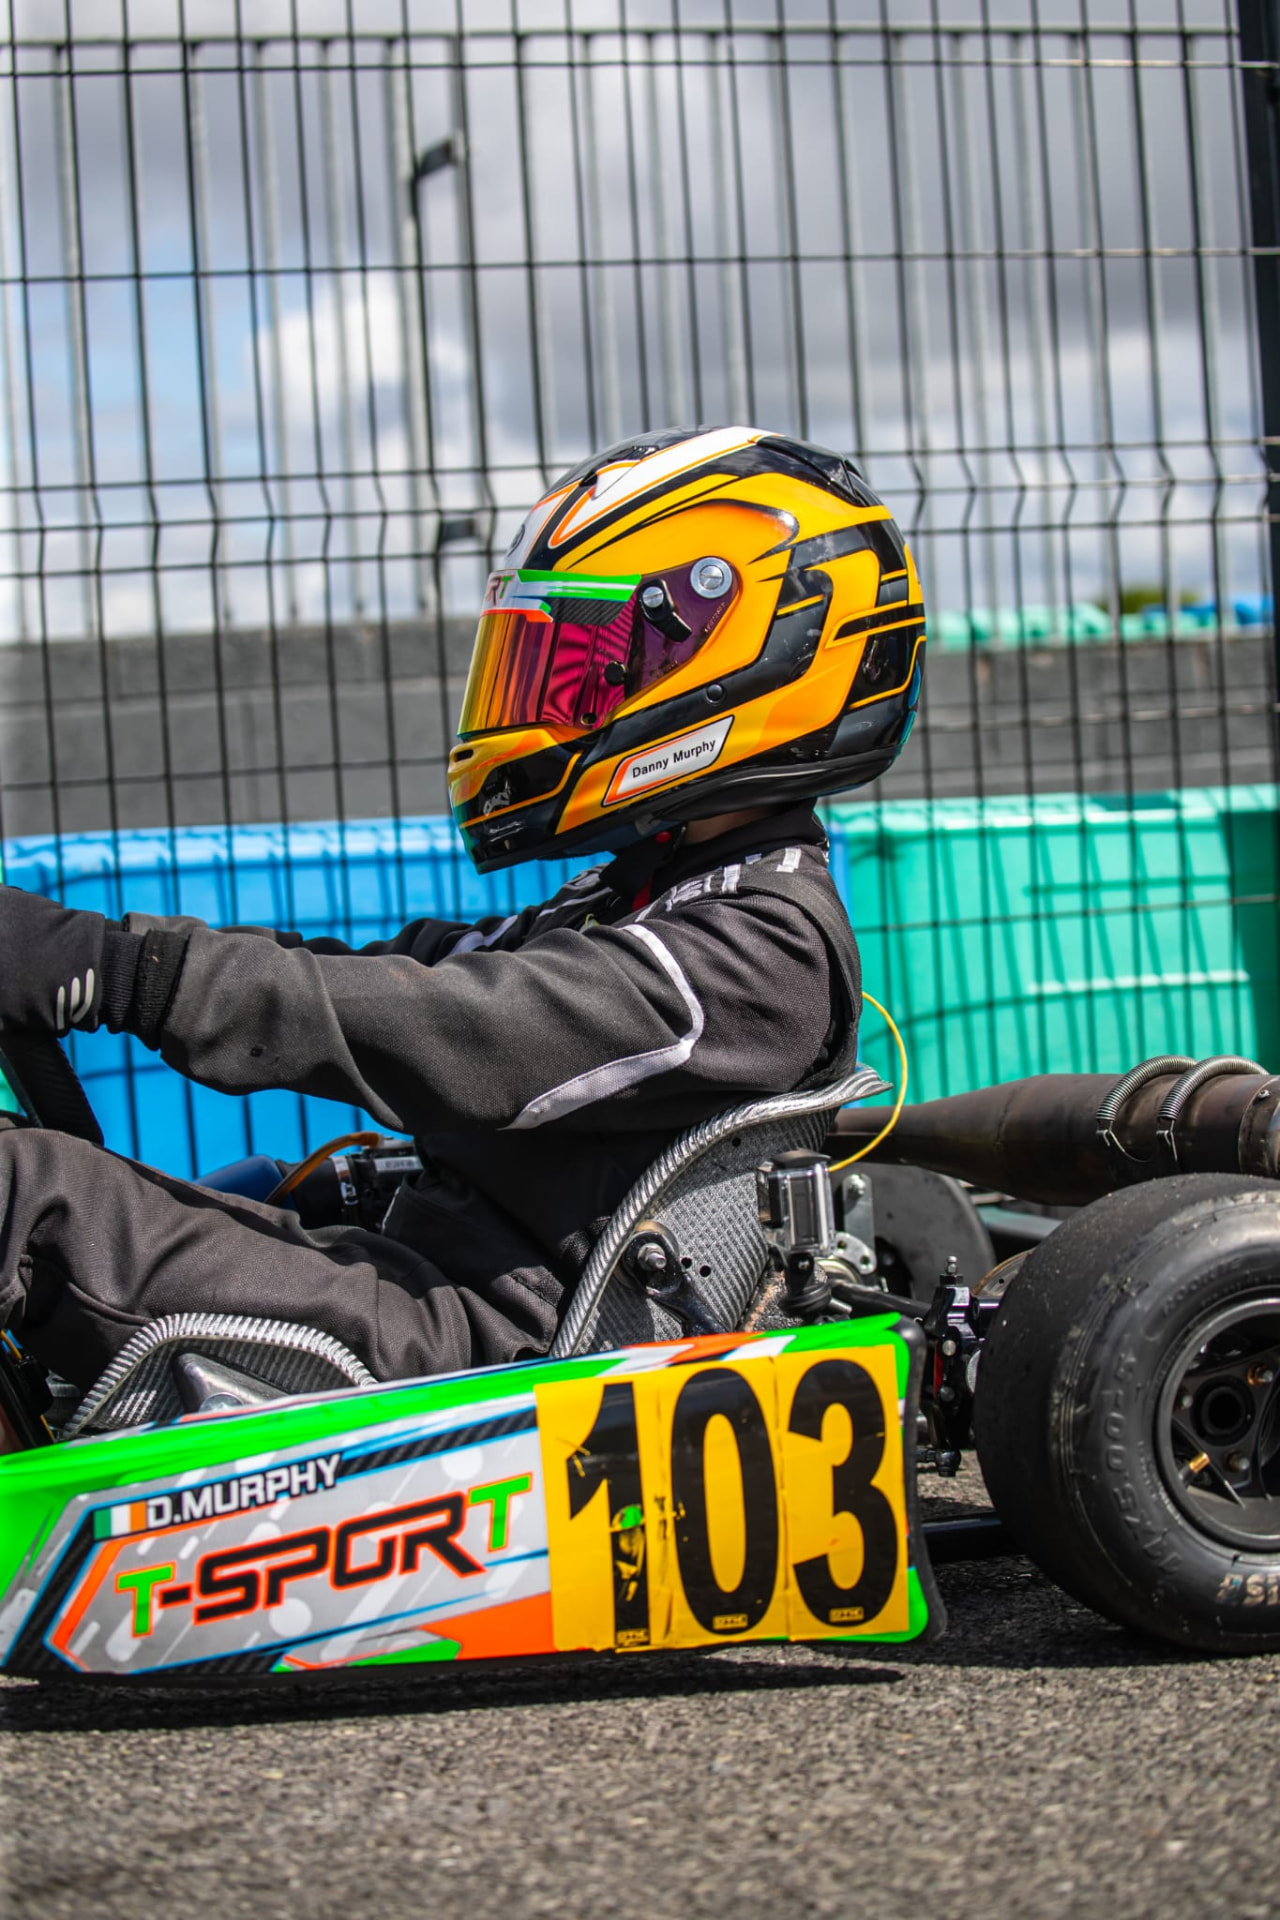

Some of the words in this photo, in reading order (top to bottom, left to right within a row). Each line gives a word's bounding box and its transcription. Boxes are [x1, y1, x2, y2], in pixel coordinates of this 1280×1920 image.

[632, 758, 669, 778] Danny
[673, 740, 716, 763] Murphy
[147, 1453, 342, 1530] D.MURPHY
[566, 1358, 899, 1646] 103
[115, 1472, 533, 1638] T-SPORT
